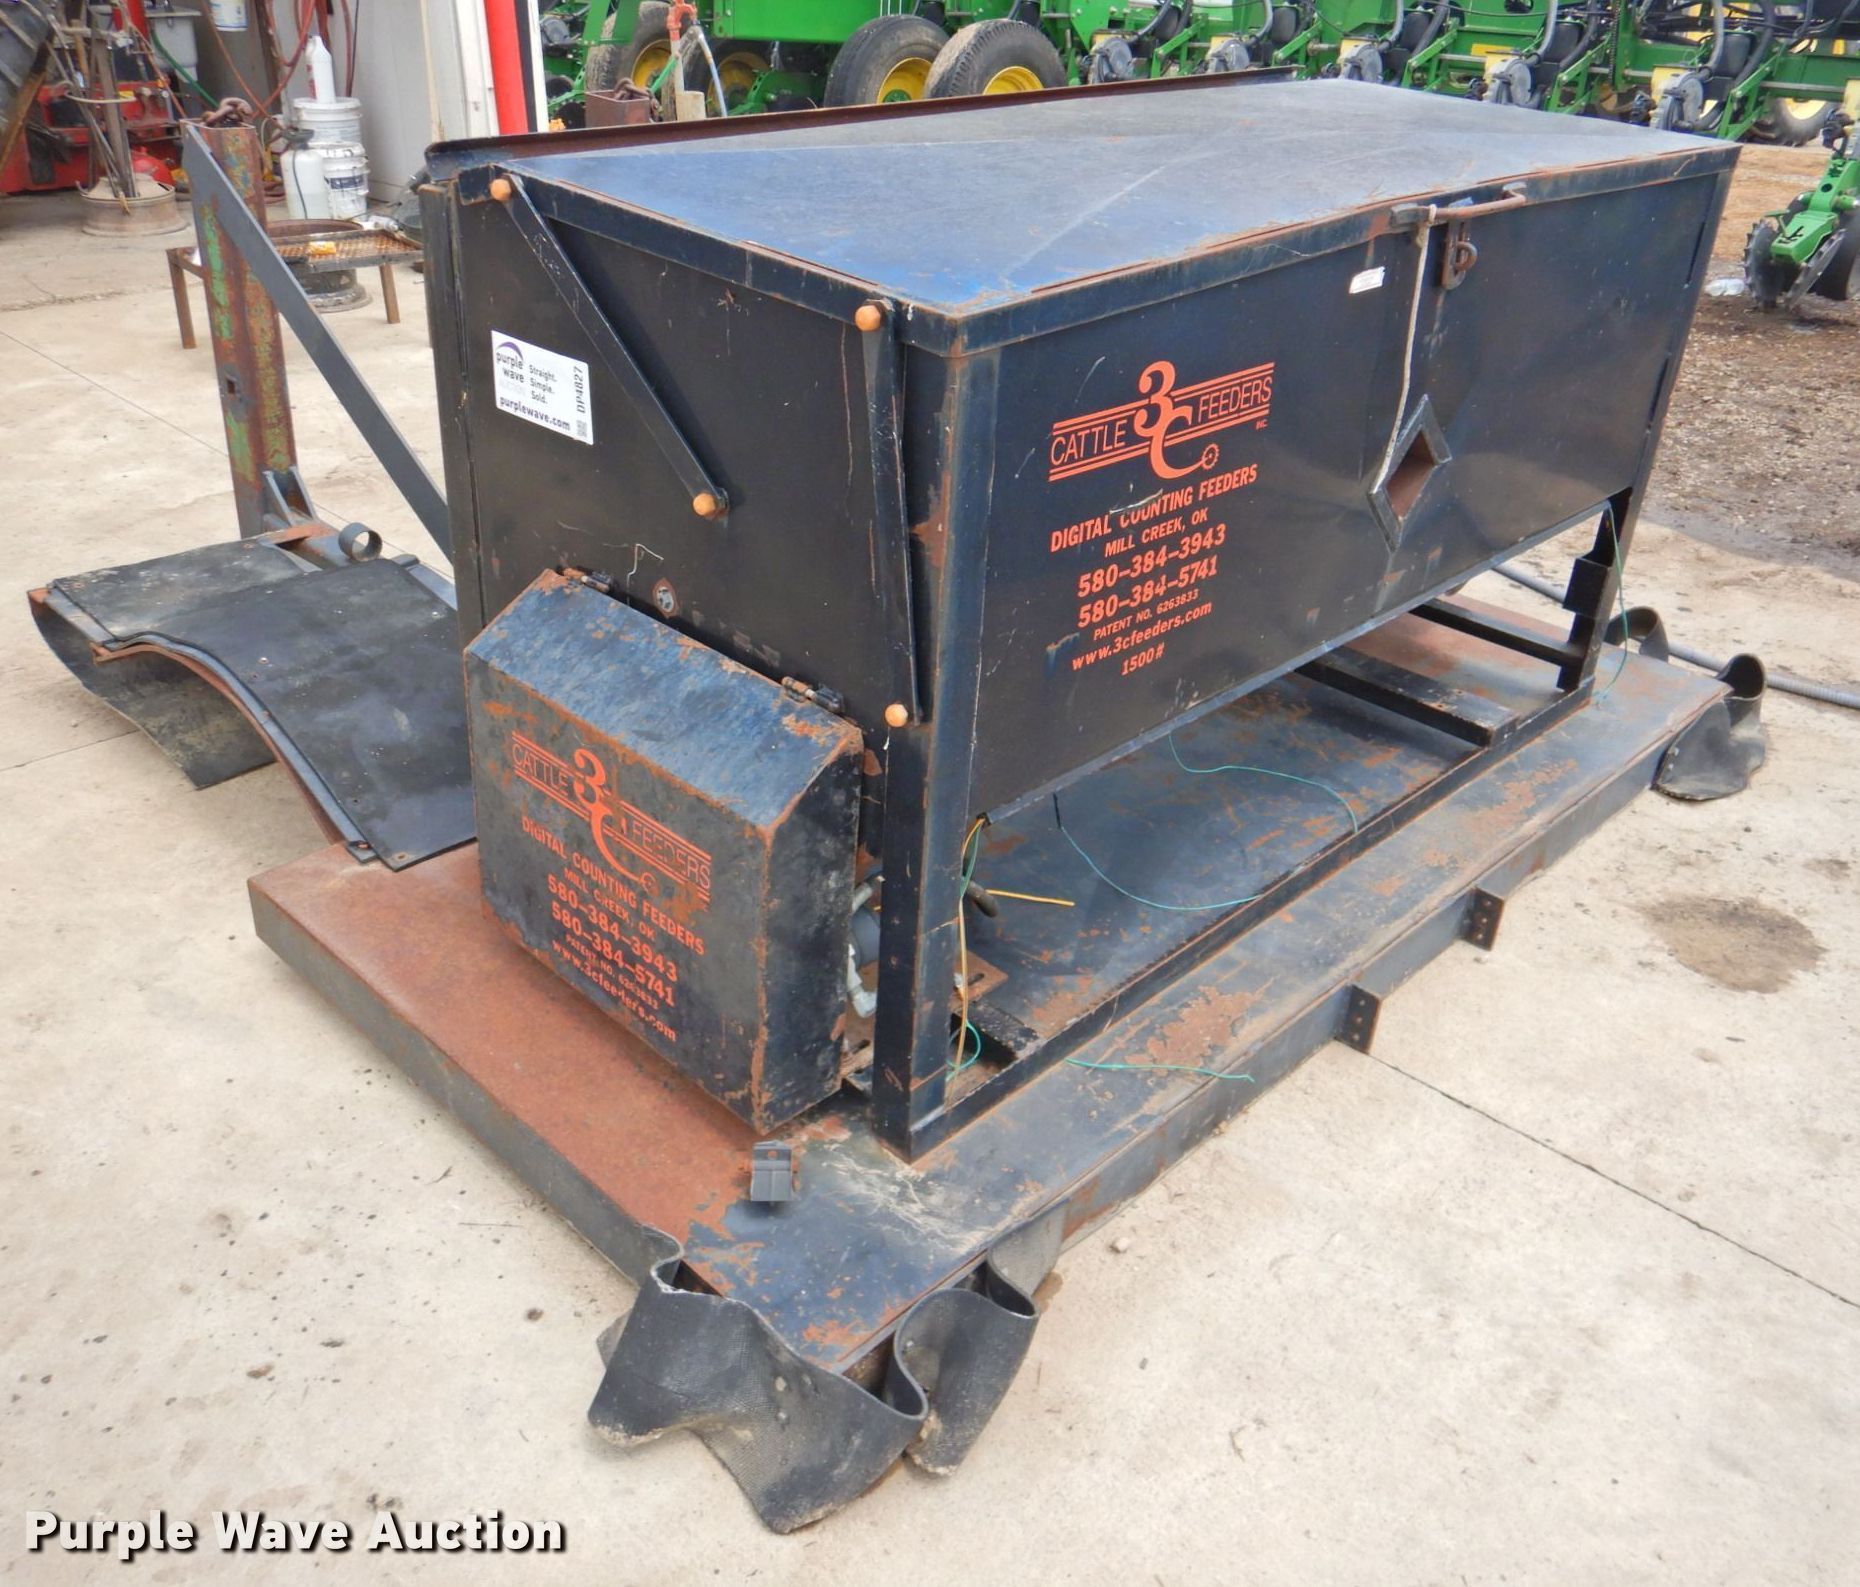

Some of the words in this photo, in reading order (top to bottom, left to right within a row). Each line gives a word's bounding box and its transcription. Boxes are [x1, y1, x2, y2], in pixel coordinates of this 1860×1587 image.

[496, 352, 523, 370] purple
[502, 368, 524, 383] wave
[500, 396, 571, 431] purplewave.com
[531, 390, 548, 404] Sold.
[1051, 419, 1127, 466] CATTLE
[1198, 377, 1273, 423] FEEDERS
[1051, 513, 1112, 552] DIGITAL
[1199, 464, 1257, 501] FEEDERS
[1105, 538, 1135, 557] MILL
[1142, 519, 1185, 544] CREEK,
[1192, 508, 1209, 524] OK
[1078, 524, 1226, 597] 580-384-3943
[1078, 555, 1218, 628] 580-384-5741
[1072, 602, 1213, 671] www.3cfeeders.com
[1093, 615, 1132, 640] PATENT
[1136, 608, 1153, 624] NO.
[1121, 642, 1165, 676] 1500#
[512, 743, 569, 796] CATTLE
[521, 816, 567, 859] DIGITAL
[573, 852, 636, 908] COUNTING
[643, 900, 704, 955] FEEDERS
[564, 868, 589, 893] MILL
[548, 874, 677, 982] 580-384-3943
[552, 901, 675, 1007] 580-384-5741
